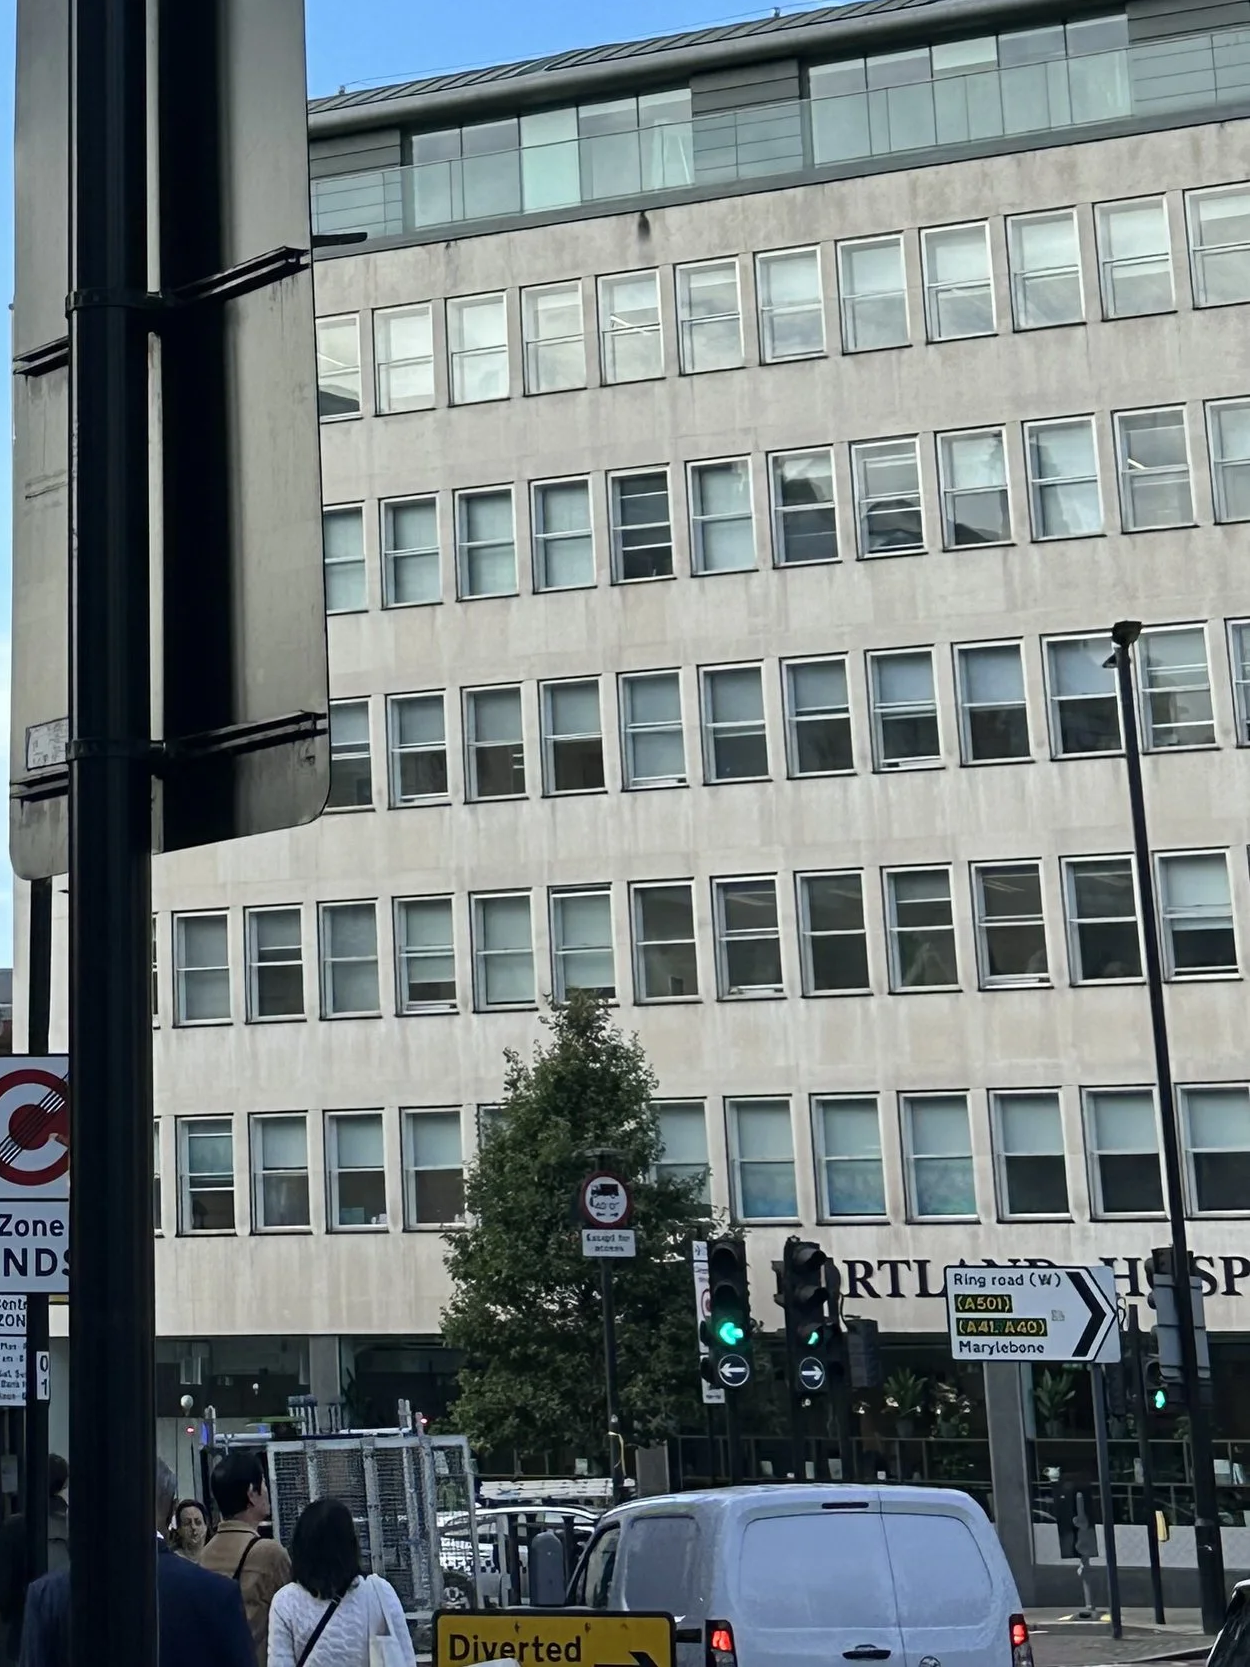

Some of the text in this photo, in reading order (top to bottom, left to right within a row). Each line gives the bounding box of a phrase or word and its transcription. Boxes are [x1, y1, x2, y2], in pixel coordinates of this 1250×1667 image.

[954, 1273, 986, 1288] Ring
[992, 1273, 1024, 1285] road
[957, 1296, 1010, 1311] (A501)
[959, 1341, 1044, 1355] Marylebone
[449, 1634, 582, 1663] Diverted
